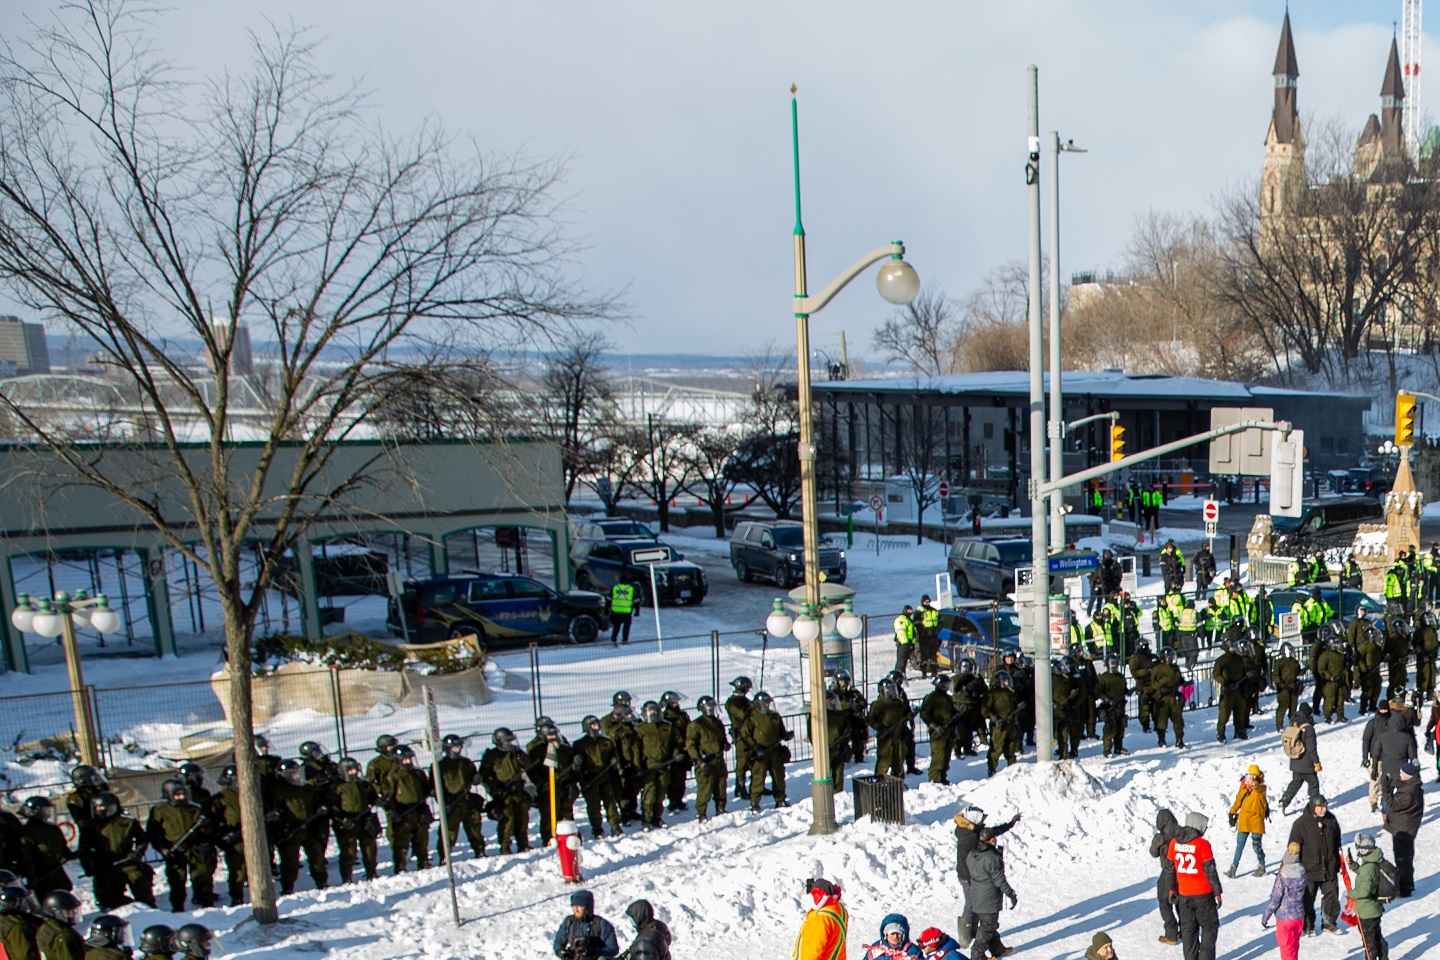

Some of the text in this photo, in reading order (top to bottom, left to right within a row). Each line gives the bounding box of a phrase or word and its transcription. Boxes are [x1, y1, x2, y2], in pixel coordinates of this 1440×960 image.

[1059, 557, 1088, 569] Wellington
[1174, 842, 1196, 854] FREEDOM
[1175, 853, 1198, 874] 22
